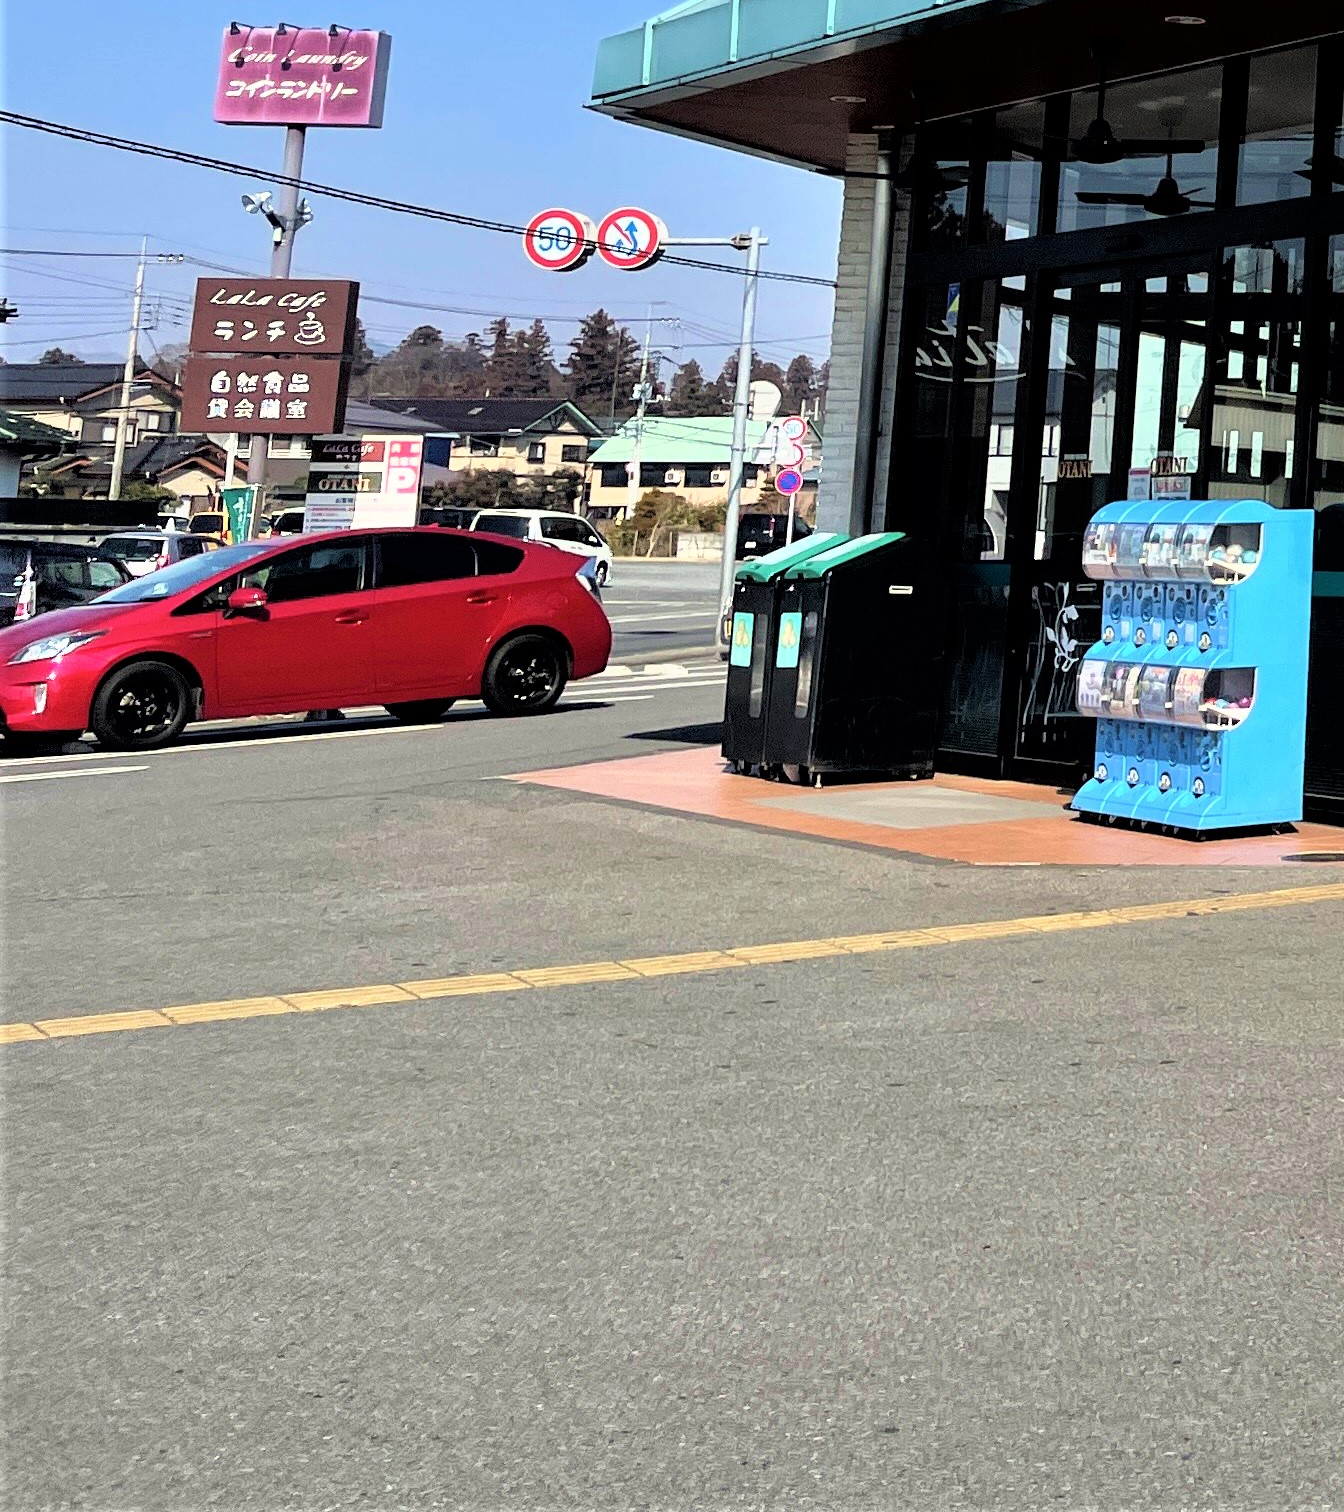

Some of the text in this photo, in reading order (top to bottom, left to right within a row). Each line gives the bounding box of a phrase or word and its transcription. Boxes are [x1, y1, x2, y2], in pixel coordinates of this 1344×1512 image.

[225, 79, 359, 100] コインランドリー
[538, 226, 572, 252] 50
[209, 288, 327, 313] LaLa Cafe
[213, 320, 287, 342] ランチ
[209, 370, 311, 395] 自然食品
